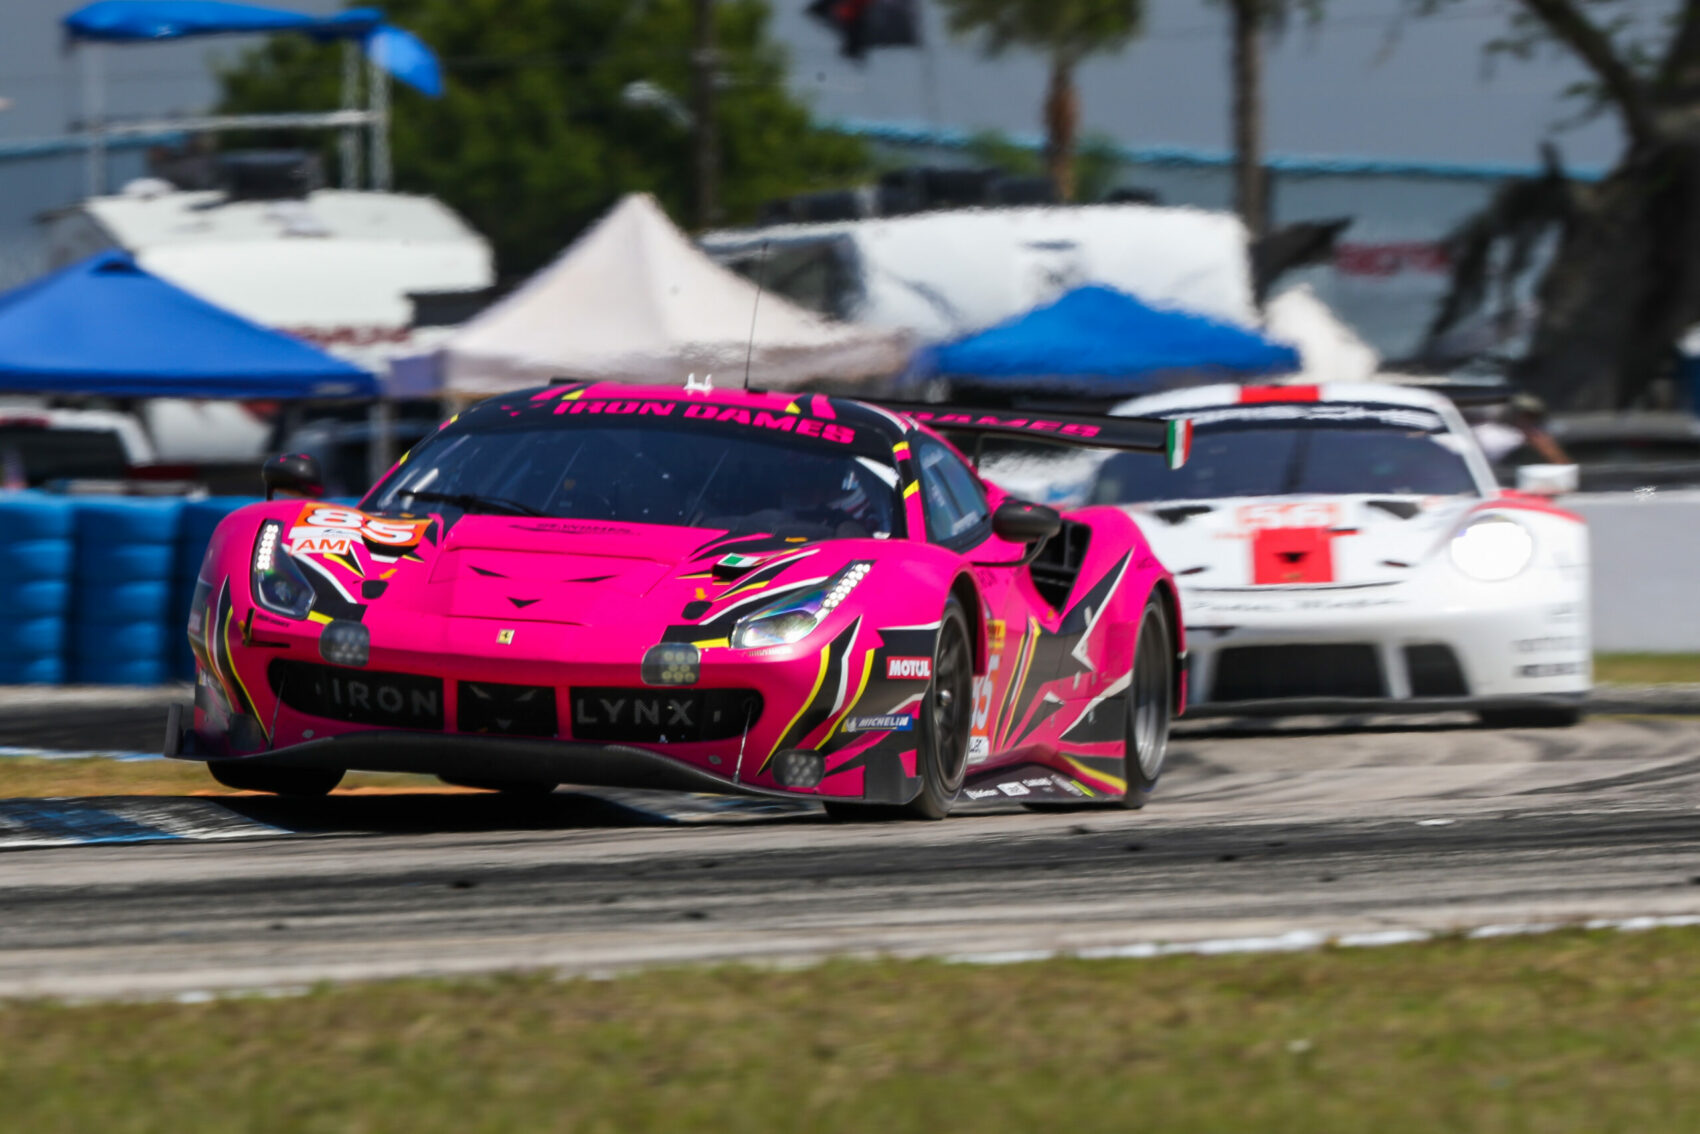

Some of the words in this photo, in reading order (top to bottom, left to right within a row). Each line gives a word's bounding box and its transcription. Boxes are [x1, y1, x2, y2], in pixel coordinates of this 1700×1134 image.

[553, 400, 675, 416] IRON
[683, 403, 856, 444] DAMES
[305, 507, 416, 544] 85
[296, 538, 347, 552] AM
[888, 659, 931, 678] MOTUL
[332, 678, 438, 717] IRON
[576, 698, 694, 726] LYNX
[858, 715, 910, 727] MICHELIN
